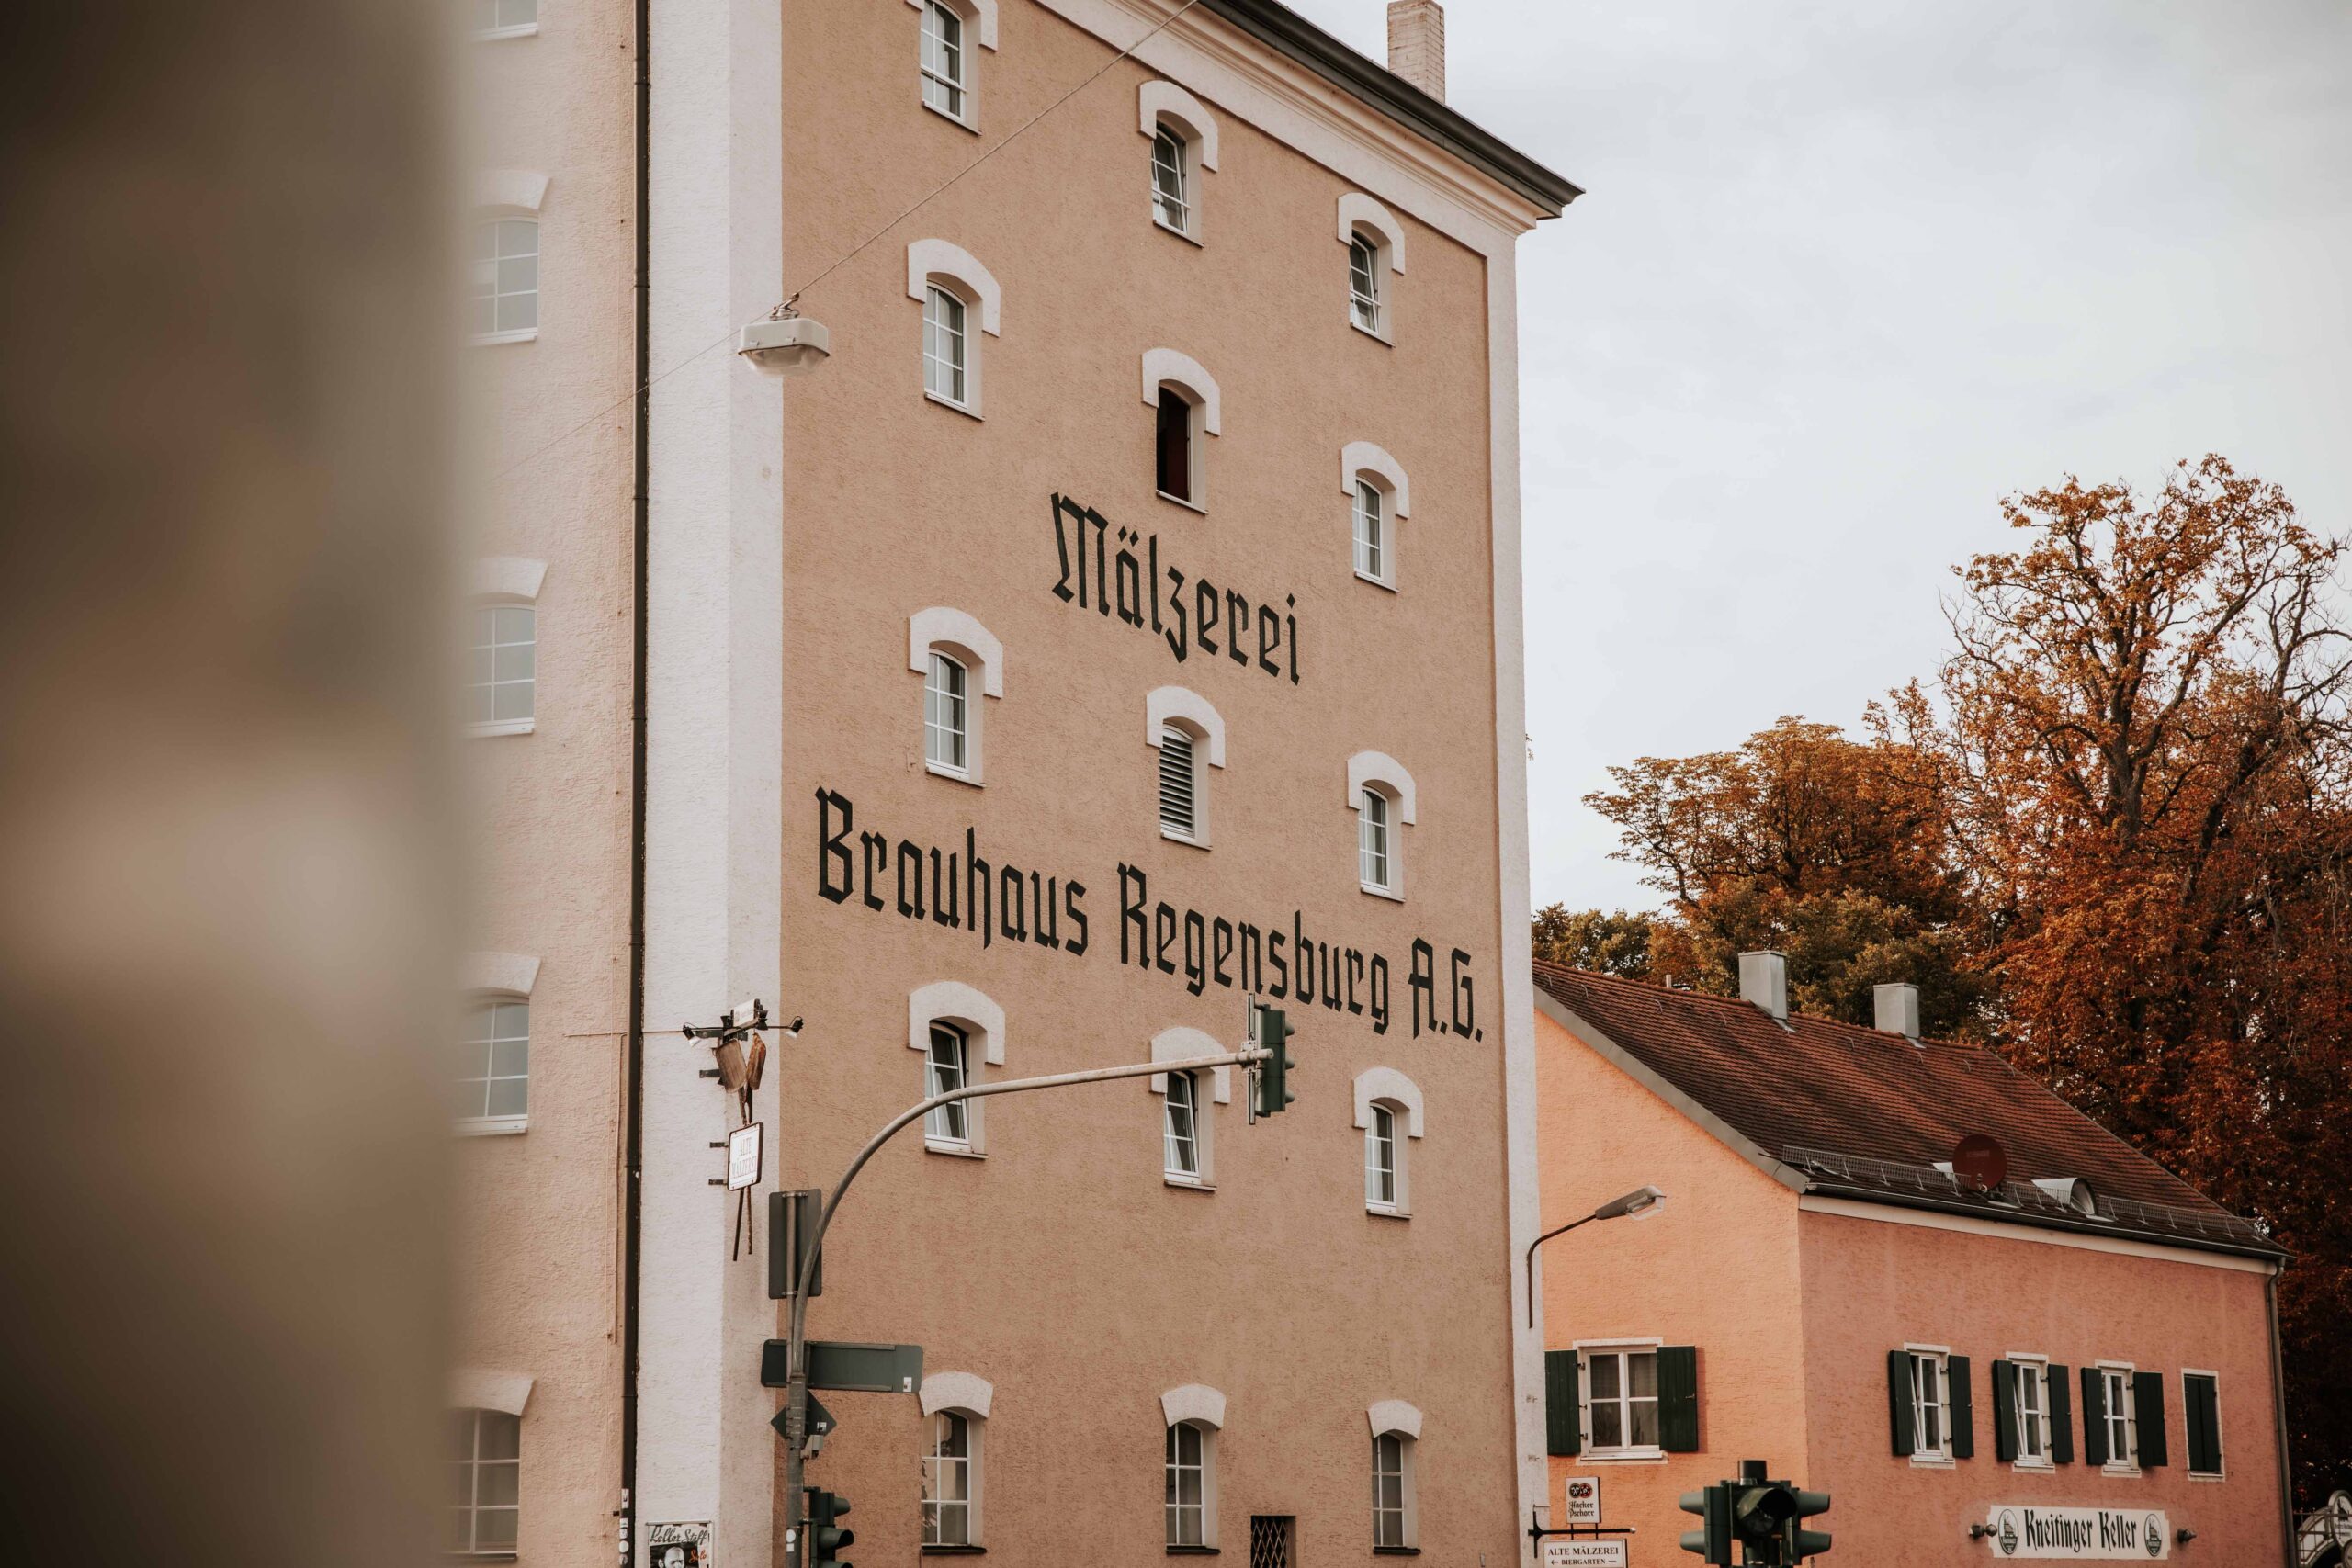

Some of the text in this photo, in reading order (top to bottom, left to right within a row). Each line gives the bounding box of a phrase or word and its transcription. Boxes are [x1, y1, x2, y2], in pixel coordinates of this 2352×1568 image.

[1050, 491, 1300, 686] Mälzerei
[814, 786, 1483, 1043] Brauhaus Regensburg A.G.
[738, 1136, 752, 1156] ALTE
[1568, 1500, 1594, 1509] Hacker
[1568, 1508, 1595, 1519] Pschorr
[2023, 1509, 2137, 1553] Kneitinger Keller
[1548, 1546, 1619, 1556] ALTE MÄLZEREI
